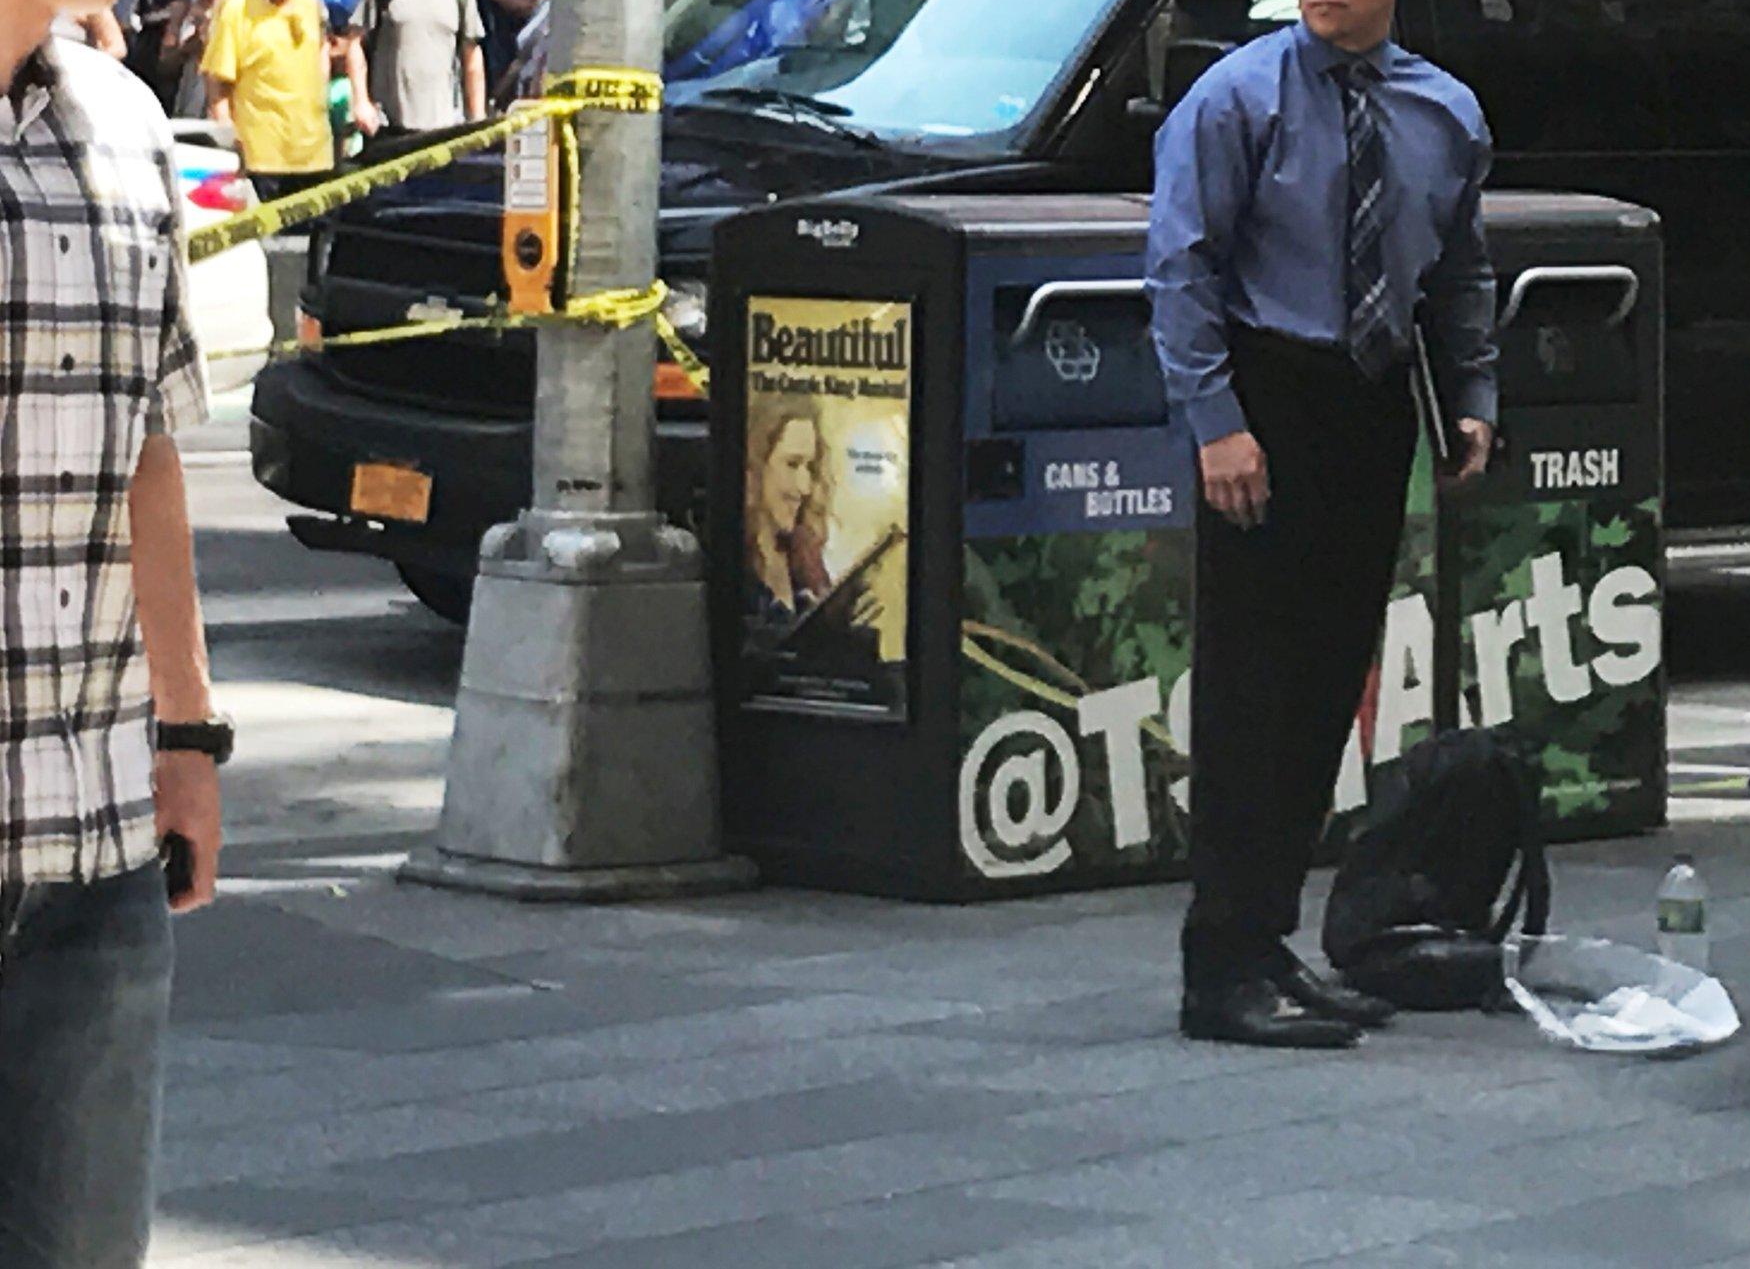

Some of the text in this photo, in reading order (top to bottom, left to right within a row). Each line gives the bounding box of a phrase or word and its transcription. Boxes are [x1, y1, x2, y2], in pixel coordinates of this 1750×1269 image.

[751, 312, 907, 371] Beautiful
[1045, 463, 1099, 490] CANS
[1529, 448, 1620, 489] TRASH
[1085, 487, 1173, 518] BOTTLES
